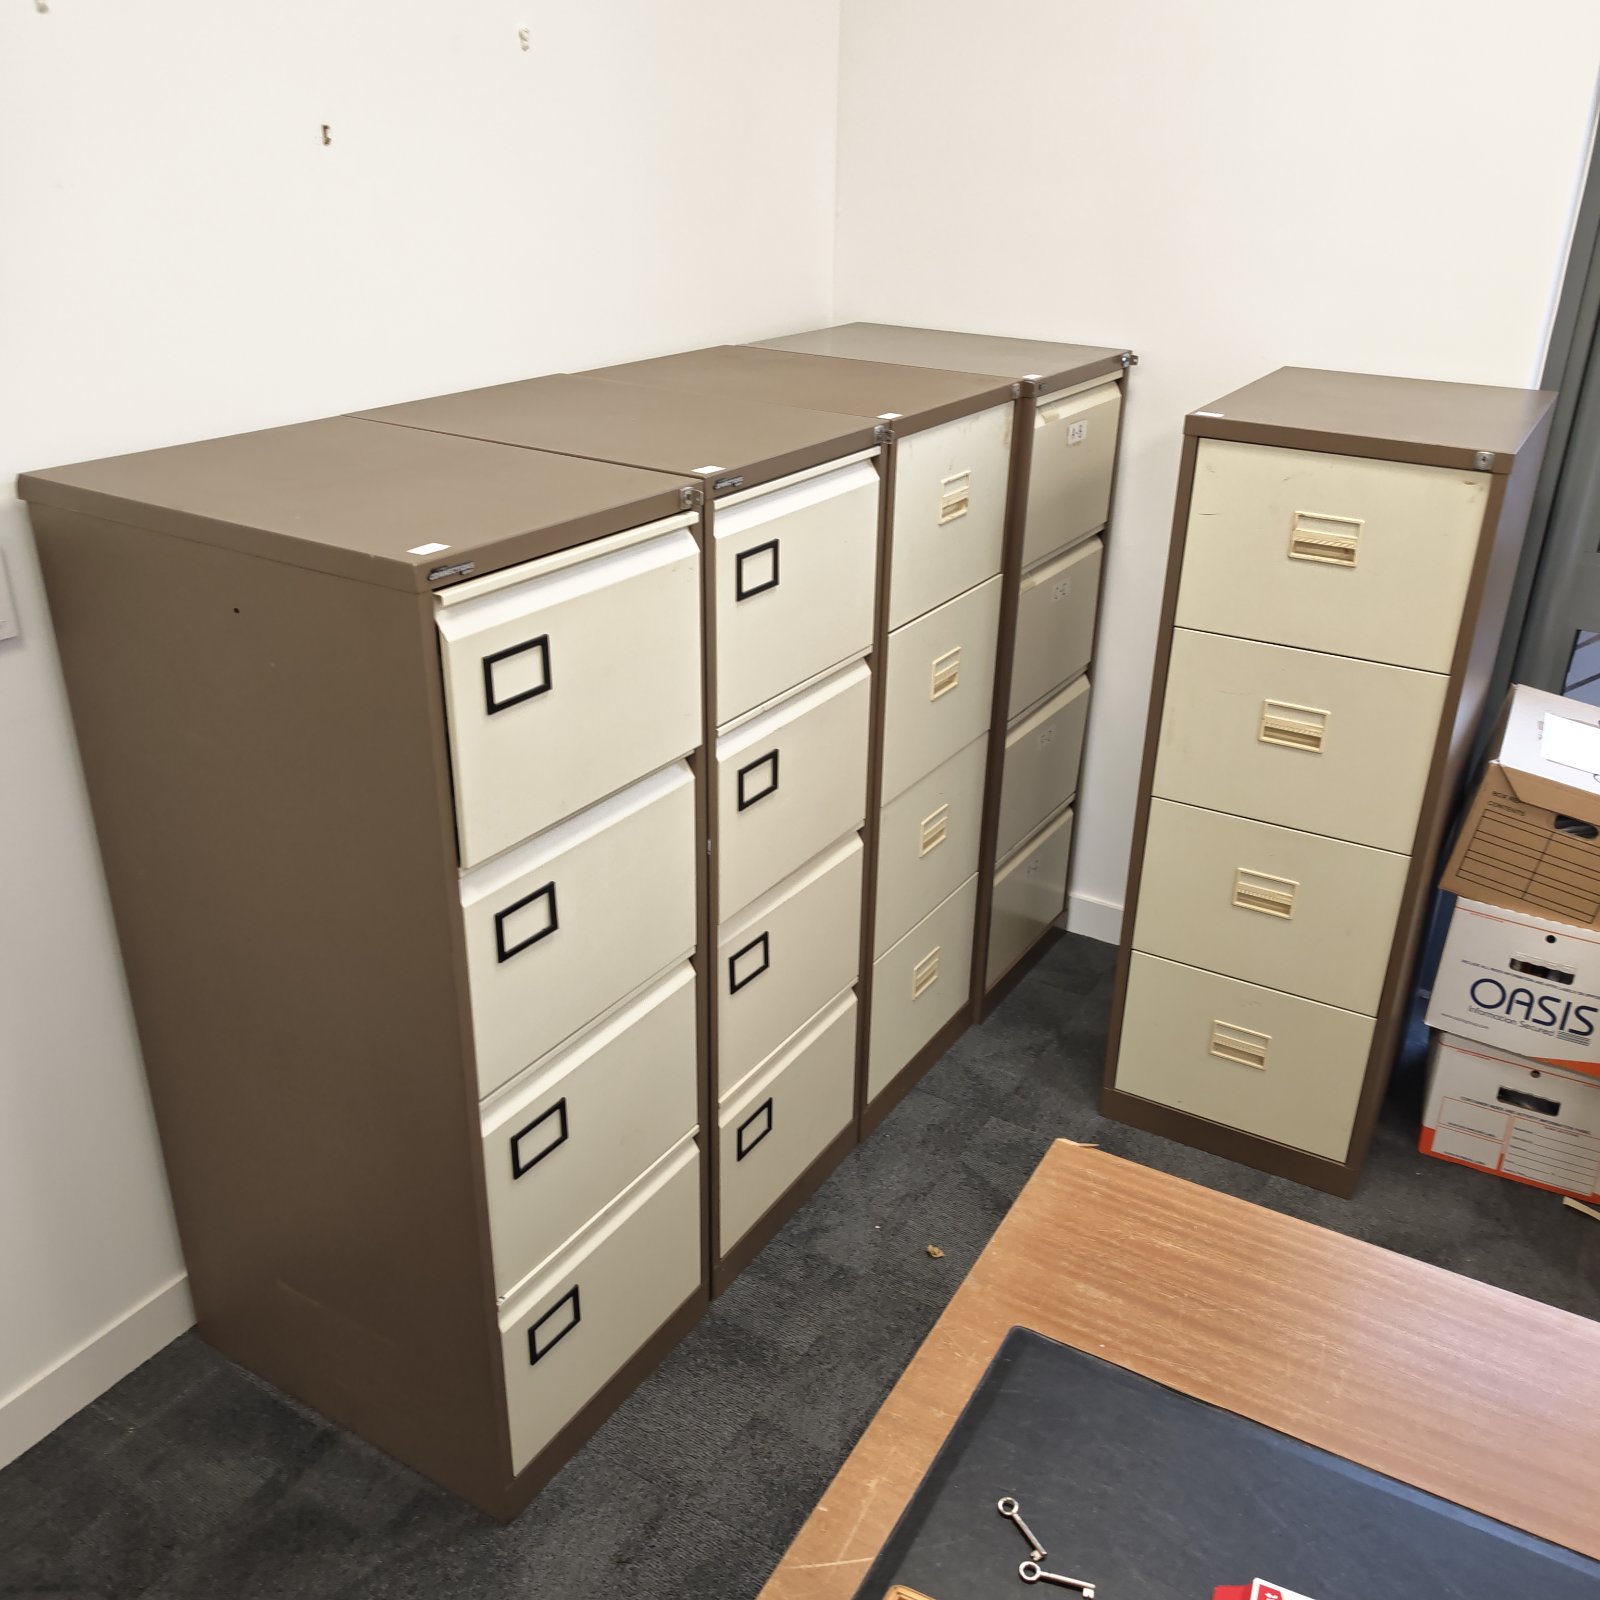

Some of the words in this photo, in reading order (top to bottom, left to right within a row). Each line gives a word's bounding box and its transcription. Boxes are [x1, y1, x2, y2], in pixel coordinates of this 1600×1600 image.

[1488, 801, 1525, 816] CONTENTS
[1468, 1005, 1517, 1026] Information
[1470, 978, 1599, 1037] OASIS
